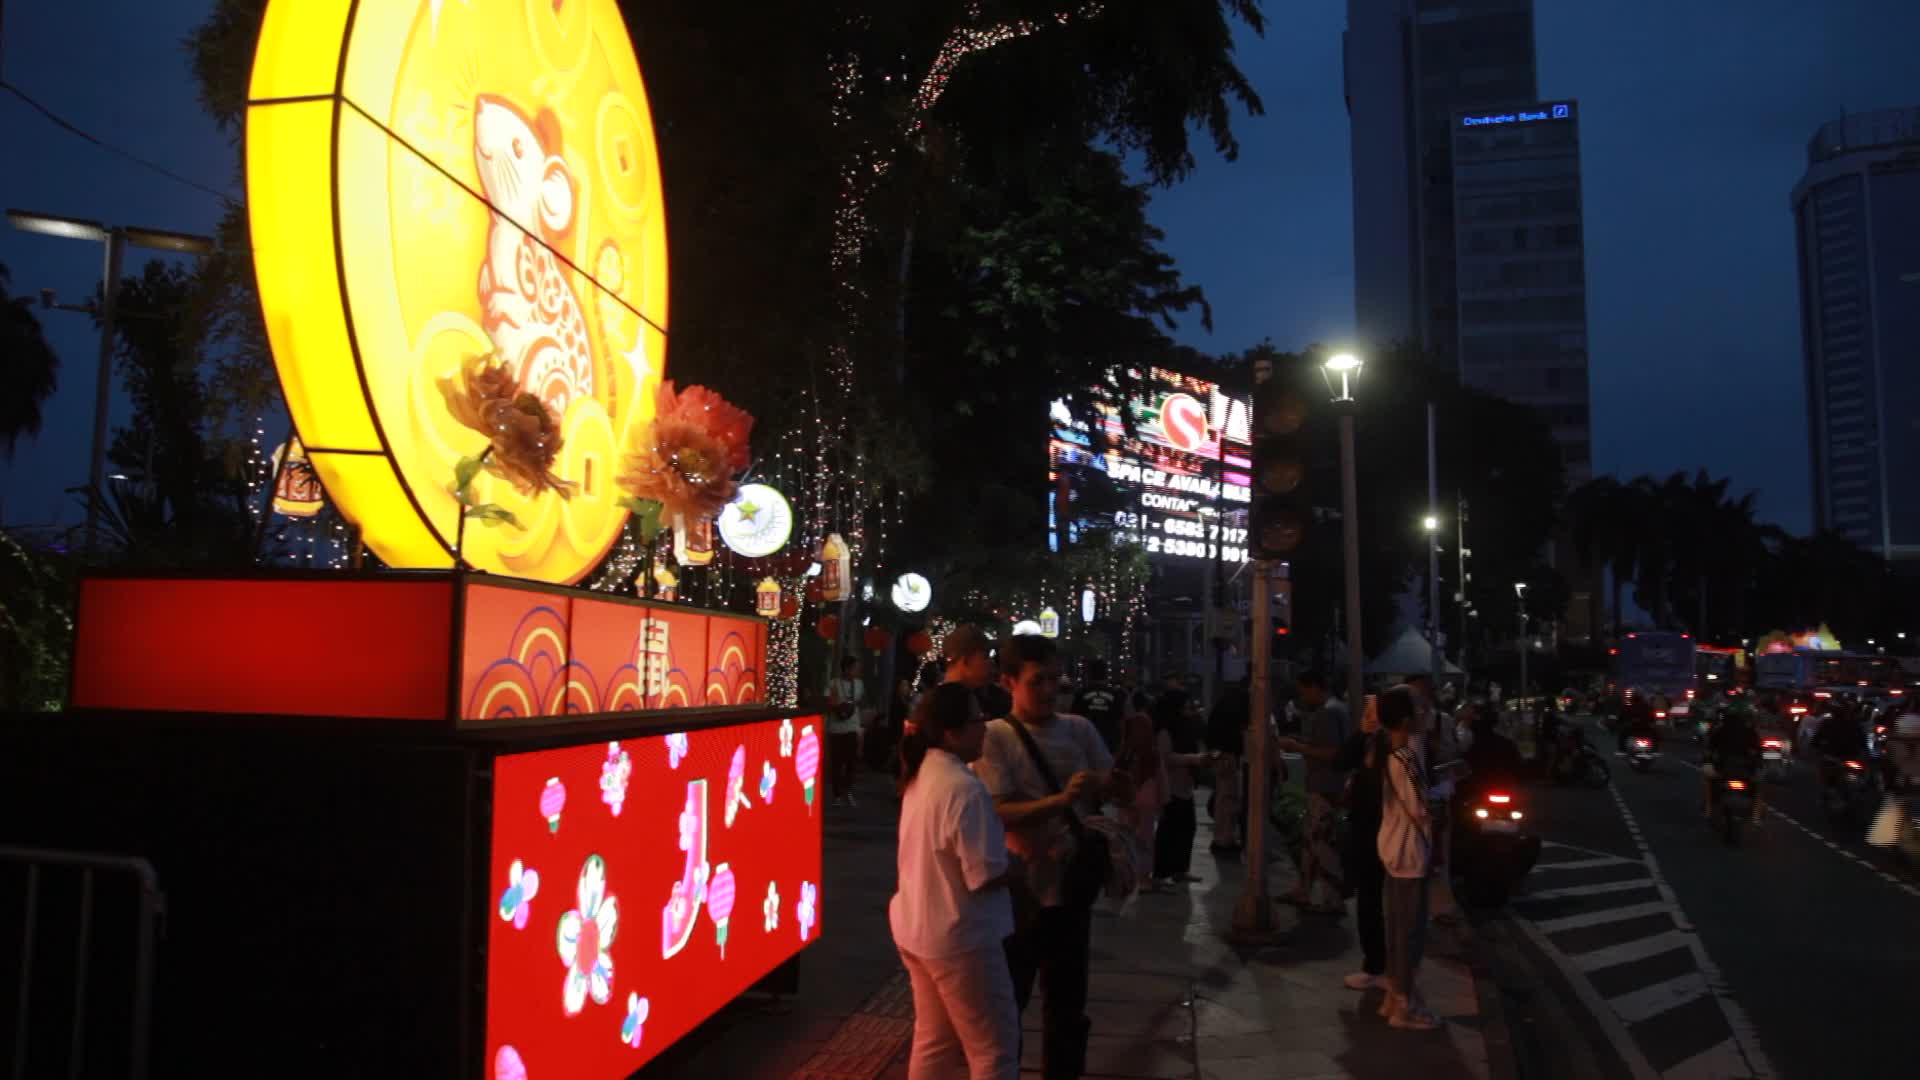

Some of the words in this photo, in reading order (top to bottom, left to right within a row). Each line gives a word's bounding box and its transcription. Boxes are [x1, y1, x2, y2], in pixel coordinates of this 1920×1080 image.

[1463, 114, 1515, 126] Deutsche
[1519, 112, 1547, 121] Bank
[1107, 461, 1167, 487] SPACE
